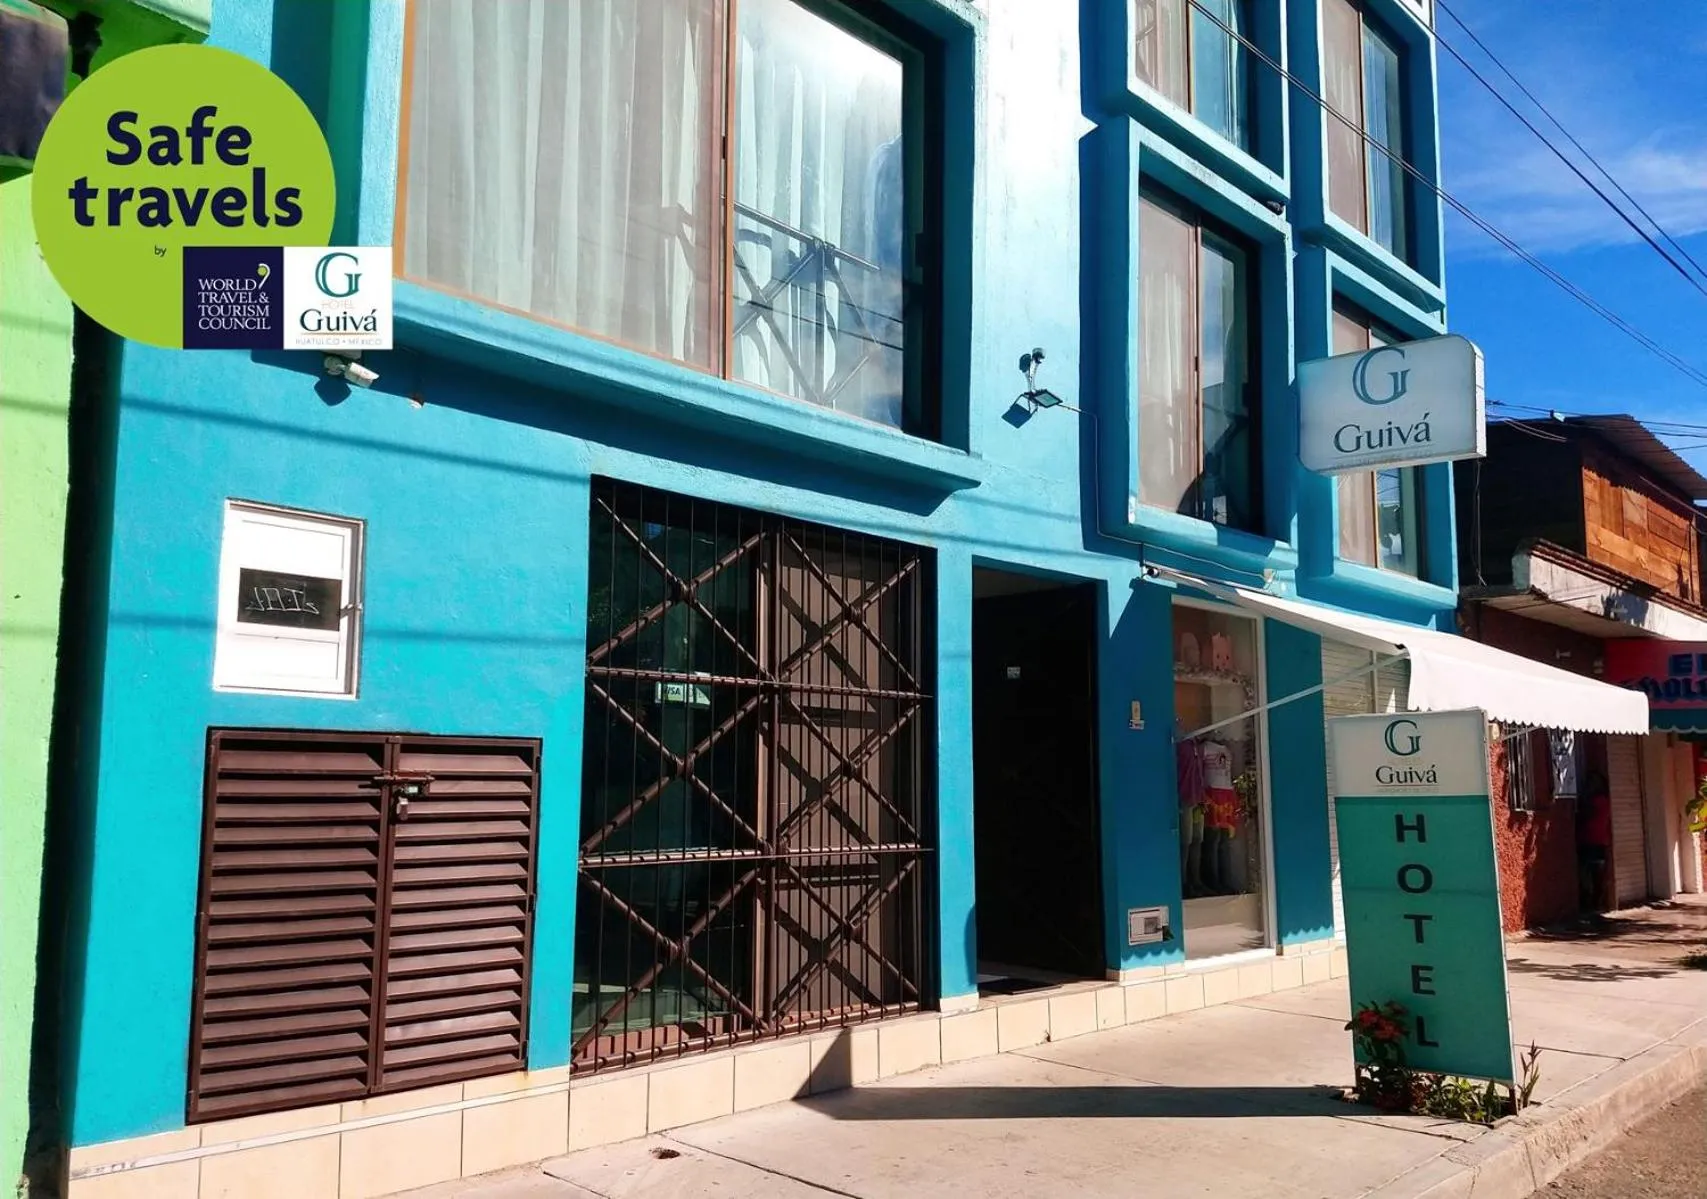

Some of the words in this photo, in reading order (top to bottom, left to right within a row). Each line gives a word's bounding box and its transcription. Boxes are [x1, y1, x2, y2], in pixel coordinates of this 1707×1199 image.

[1333, 412, 1432, 454] Guivá
[1375, 764, 1438, 785] Guivá
[1394, 813, 1439, 1048] HOTEL
